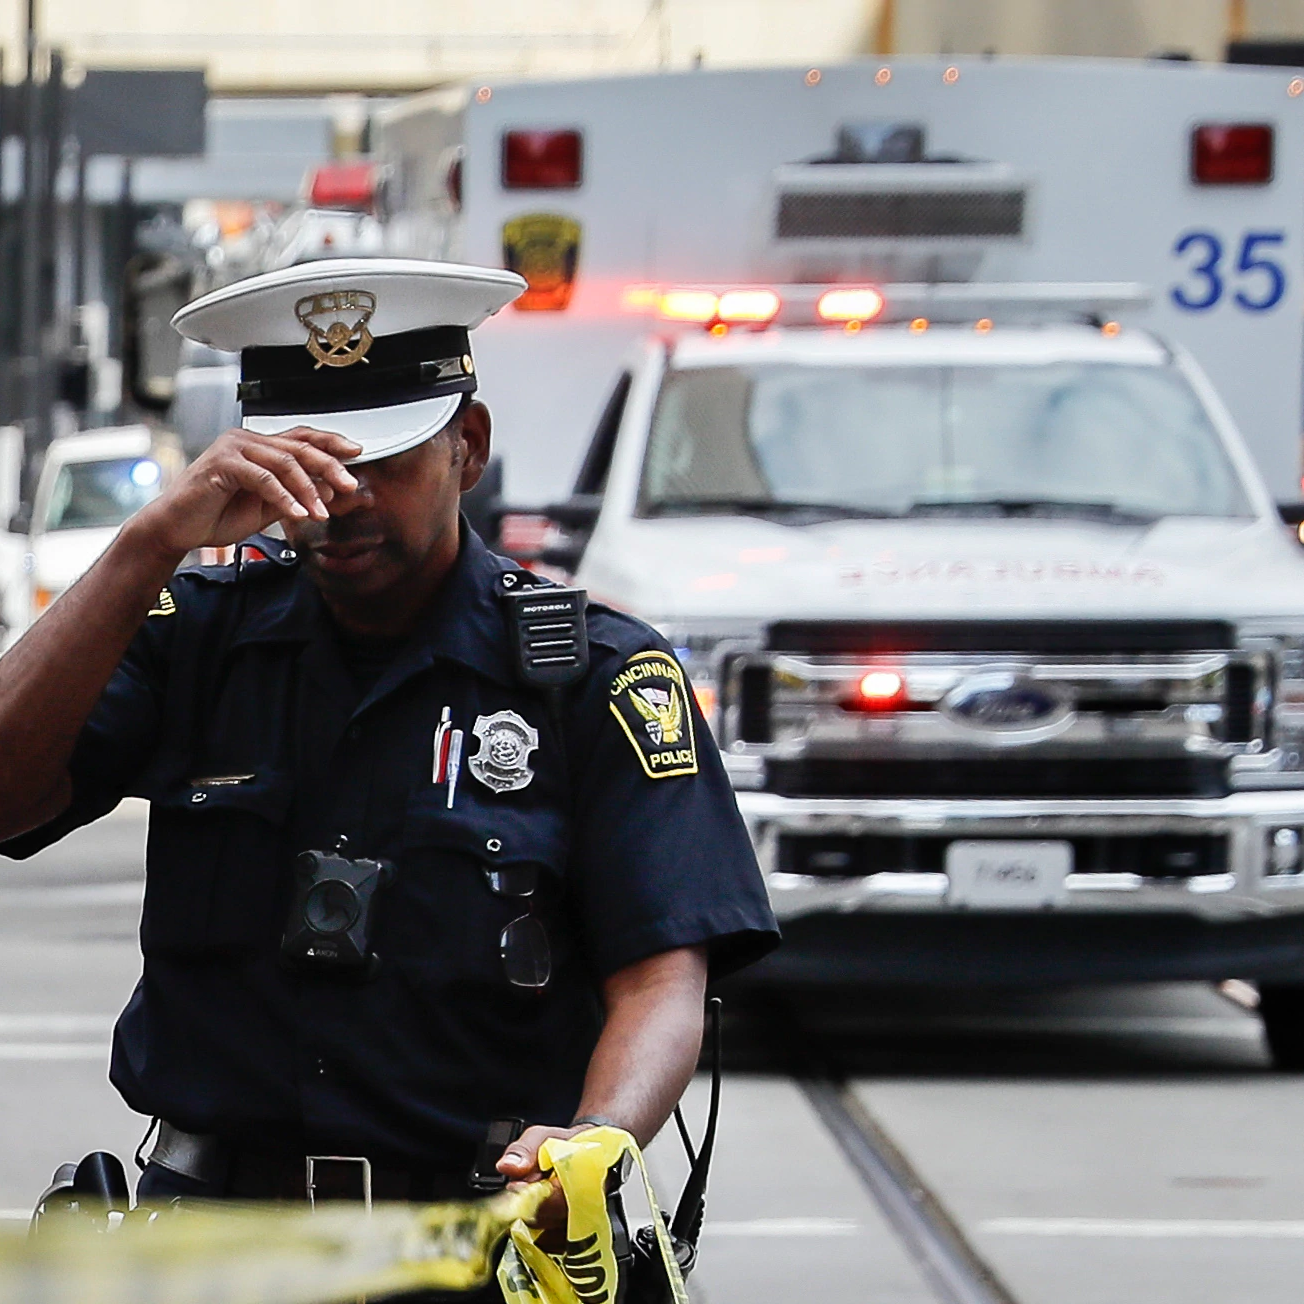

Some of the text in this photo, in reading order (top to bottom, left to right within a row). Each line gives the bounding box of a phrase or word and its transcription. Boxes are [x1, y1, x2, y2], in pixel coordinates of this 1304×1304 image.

[1172, 230, 1285, 313] 35
[523, 603, 572, 613] MOTOROLA
[649, 749, 694, 768] POLICE
